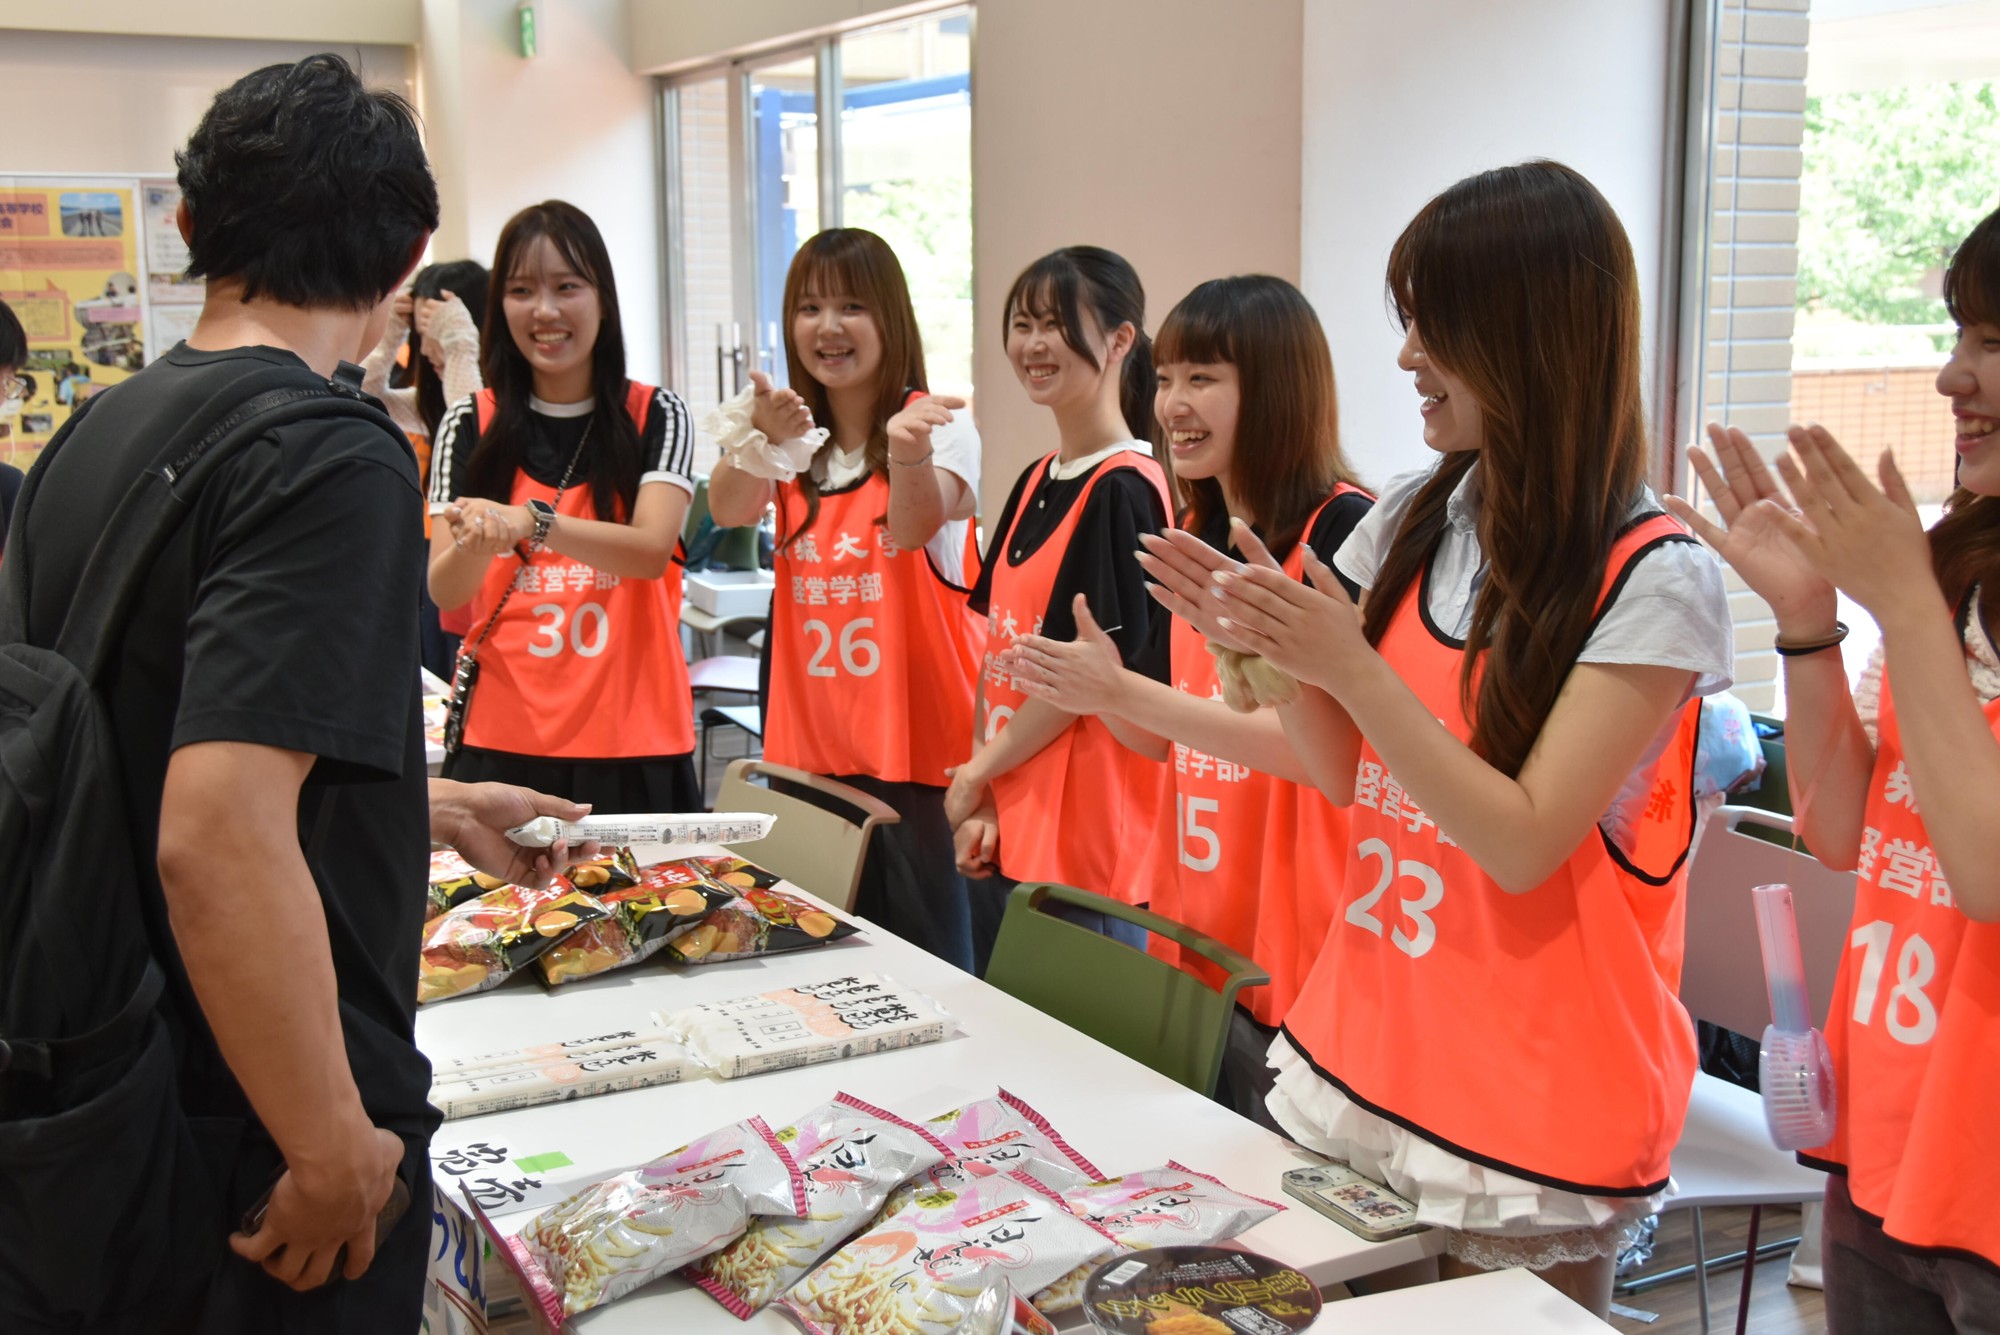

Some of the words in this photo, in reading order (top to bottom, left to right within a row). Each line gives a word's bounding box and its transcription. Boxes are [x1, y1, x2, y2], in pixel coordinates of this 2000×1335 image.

[514, 563, 621, 594] 経営学部
[527, 601, 610, 659] 30
[802, 616, 881, 678] 26
[1344, 837, 1445, 959] 23
[1850, 918, 1938, 1046] 18
